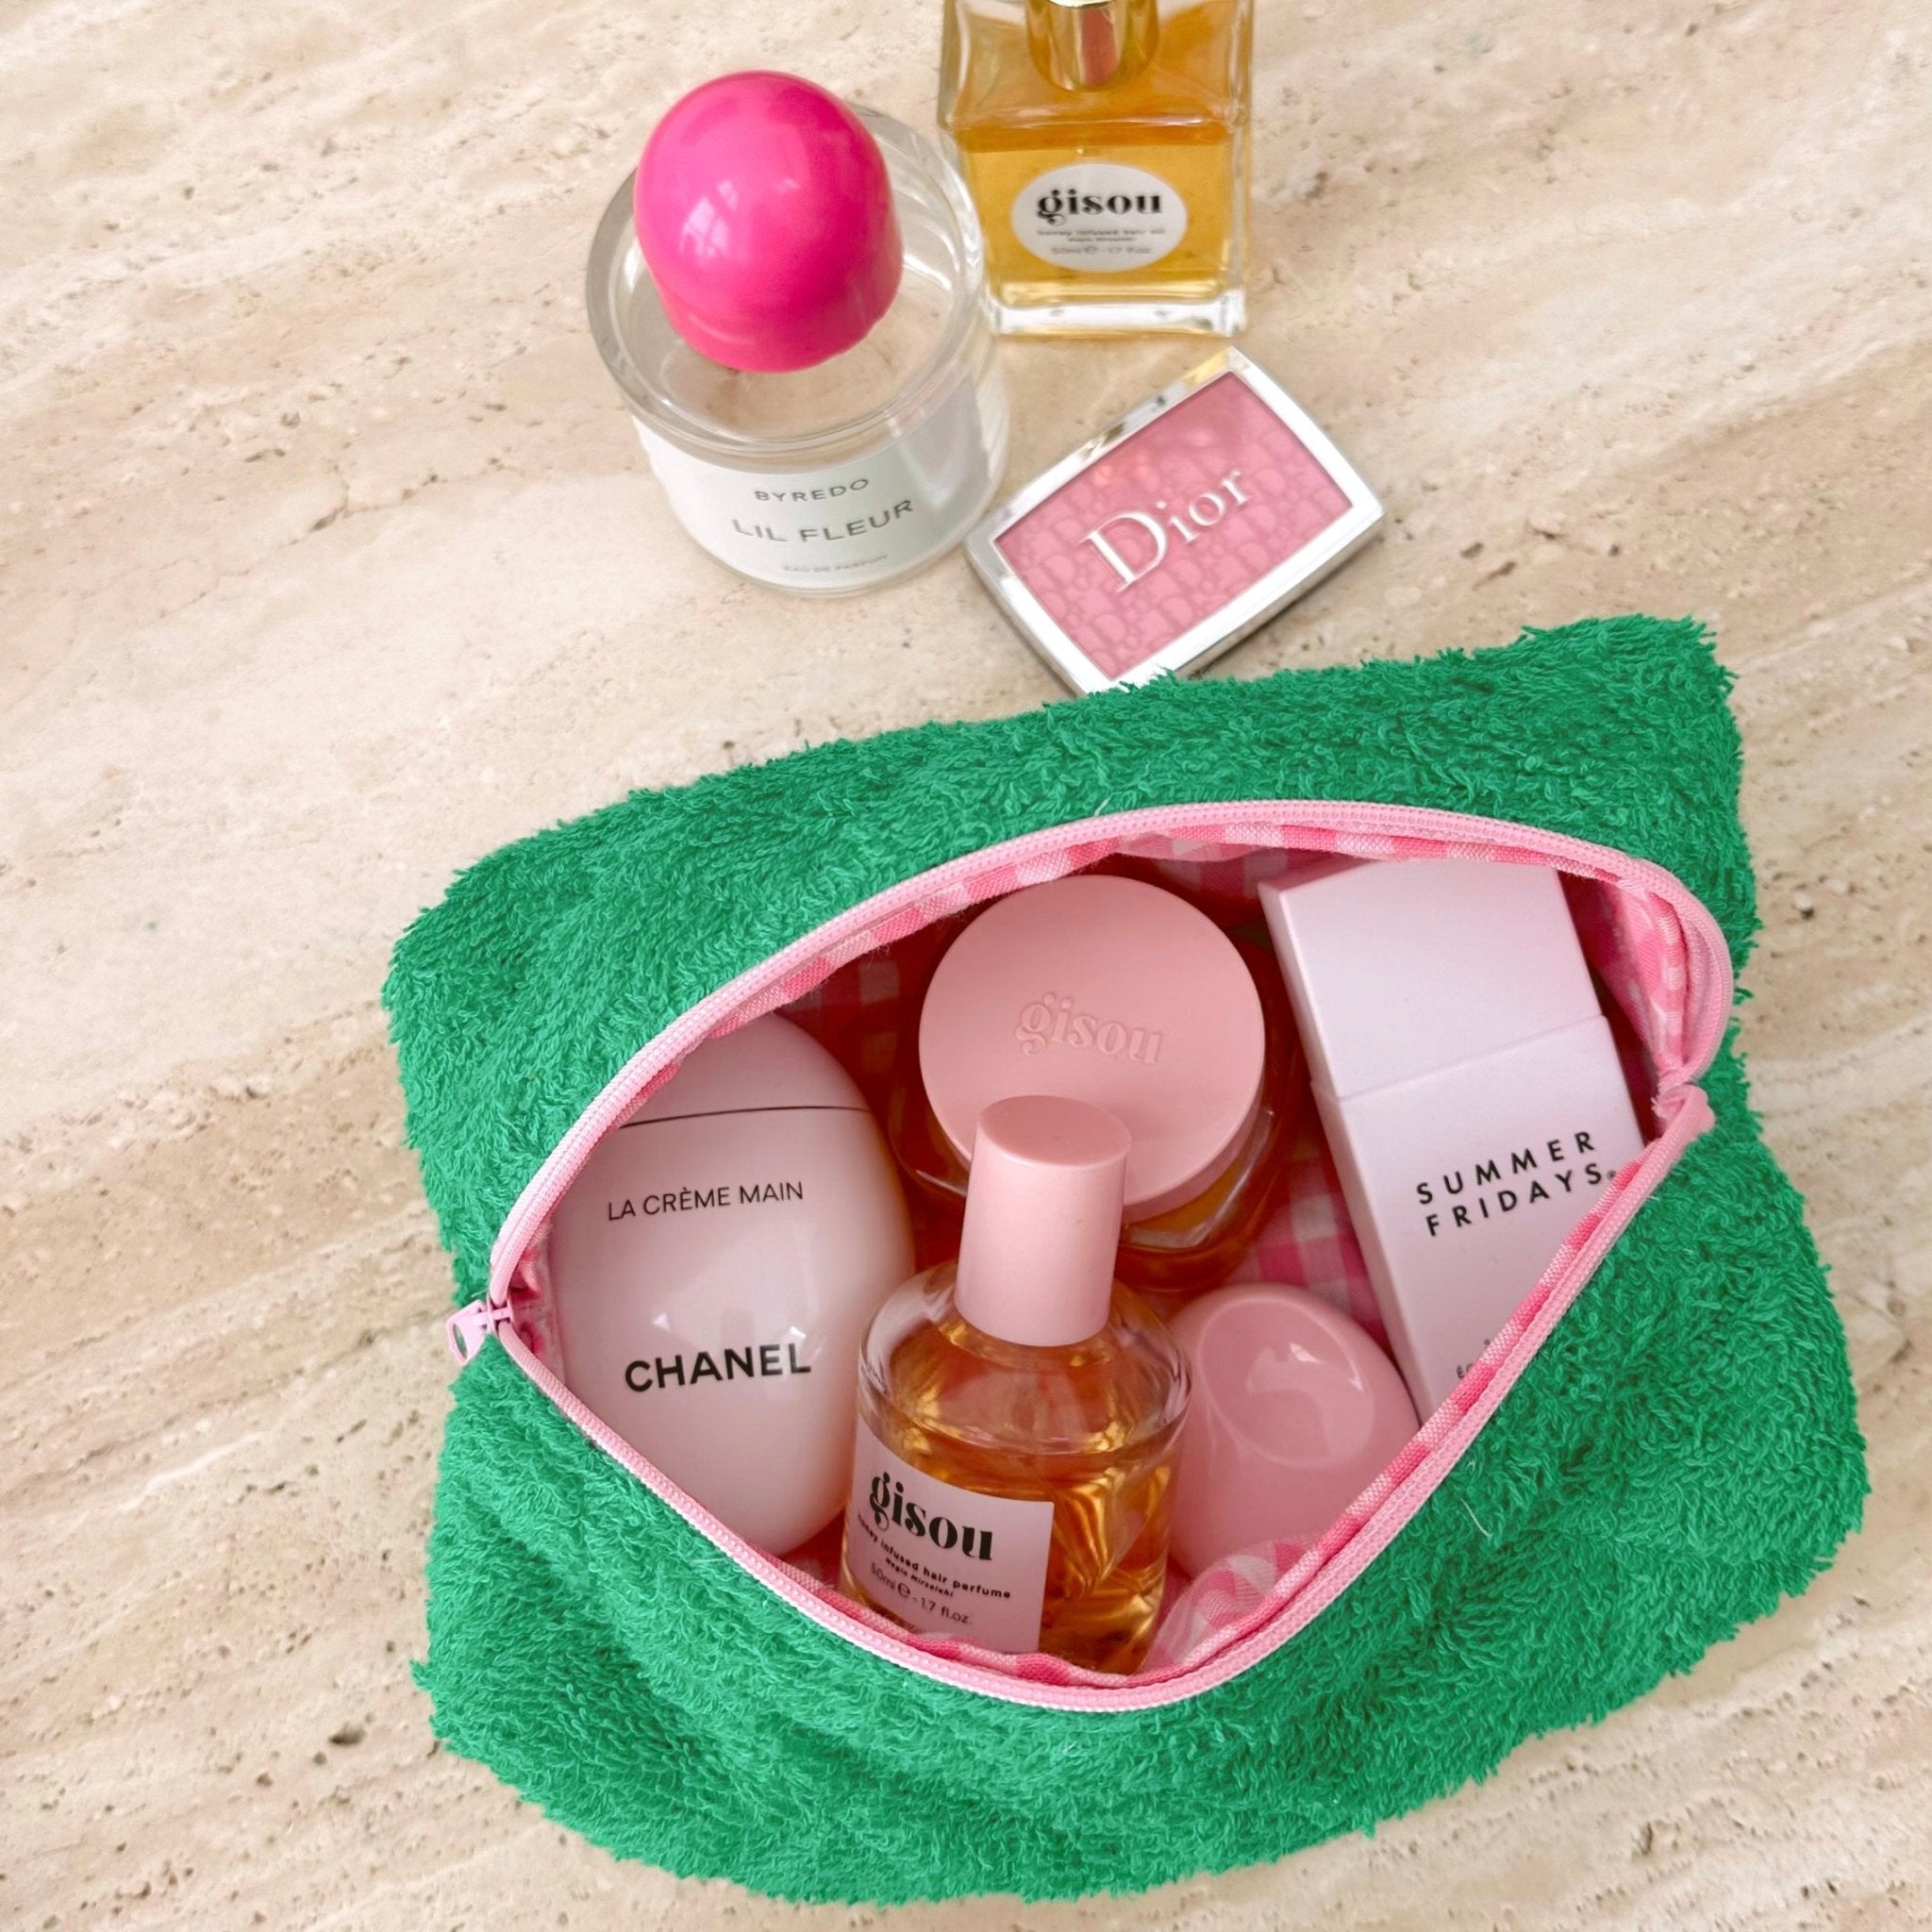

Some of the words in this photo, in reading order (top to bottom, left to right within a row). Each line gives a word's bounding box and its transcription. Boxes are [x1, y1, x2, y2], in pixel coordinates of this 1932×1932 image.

[1036, 189, 1162, 226] gisou
[755, 478, 870, 503] BYREDO
[732, 518, 789, 542] LIL
[799, 499, 914, 542] FLEUR
[1078, 469, 1254, 593] Dior
[1014, 991, 1162, 1064] gisou
[1416, 1131, 1595, 1206] SUMMER
[608, 1199, 636, 1222] LA
[643, 1186, 731, 1216] CRÈME
[740, 1181, 804, 1205] MAIN
[625, 1342, 812, 1393] CHANEL
[869, 1472, 993, 1561] gisou
[881, 1538, 920, 1572] infused
[924, 1566, 948, 1584] hair
[952, 1580, 1011, 1599] perfume
